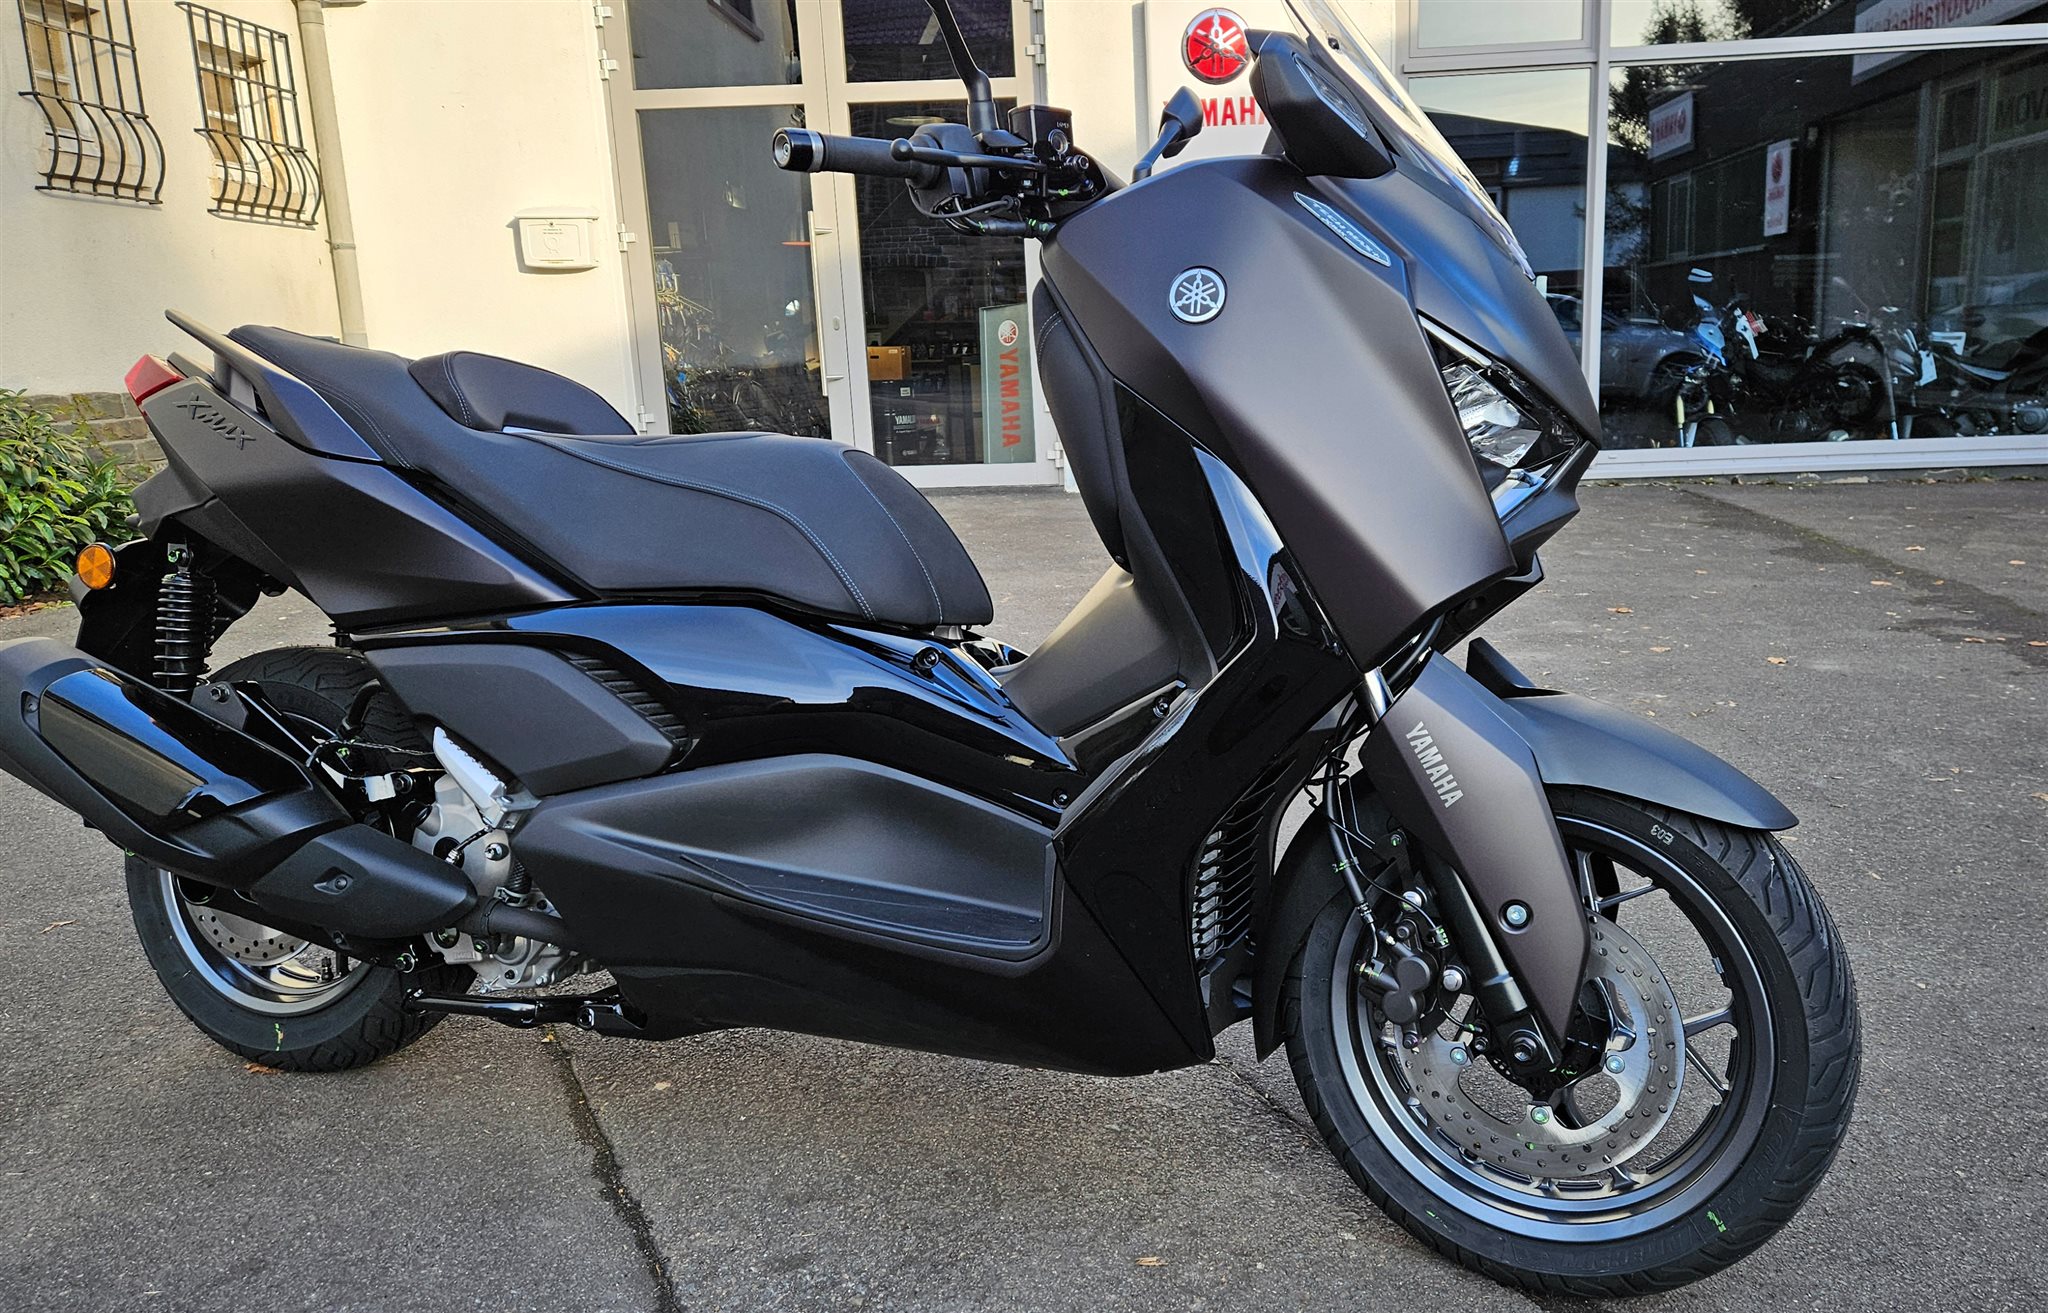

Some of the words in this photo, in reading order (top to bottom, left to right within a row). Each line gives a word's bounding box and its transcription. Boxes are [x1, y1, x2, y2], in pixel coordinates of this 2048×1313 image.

[999, 347, 1022, 448] YAMAHA
[1405, 720, 1464, 808] YAMAHA
[1650, 824, 1674, 846] E03
